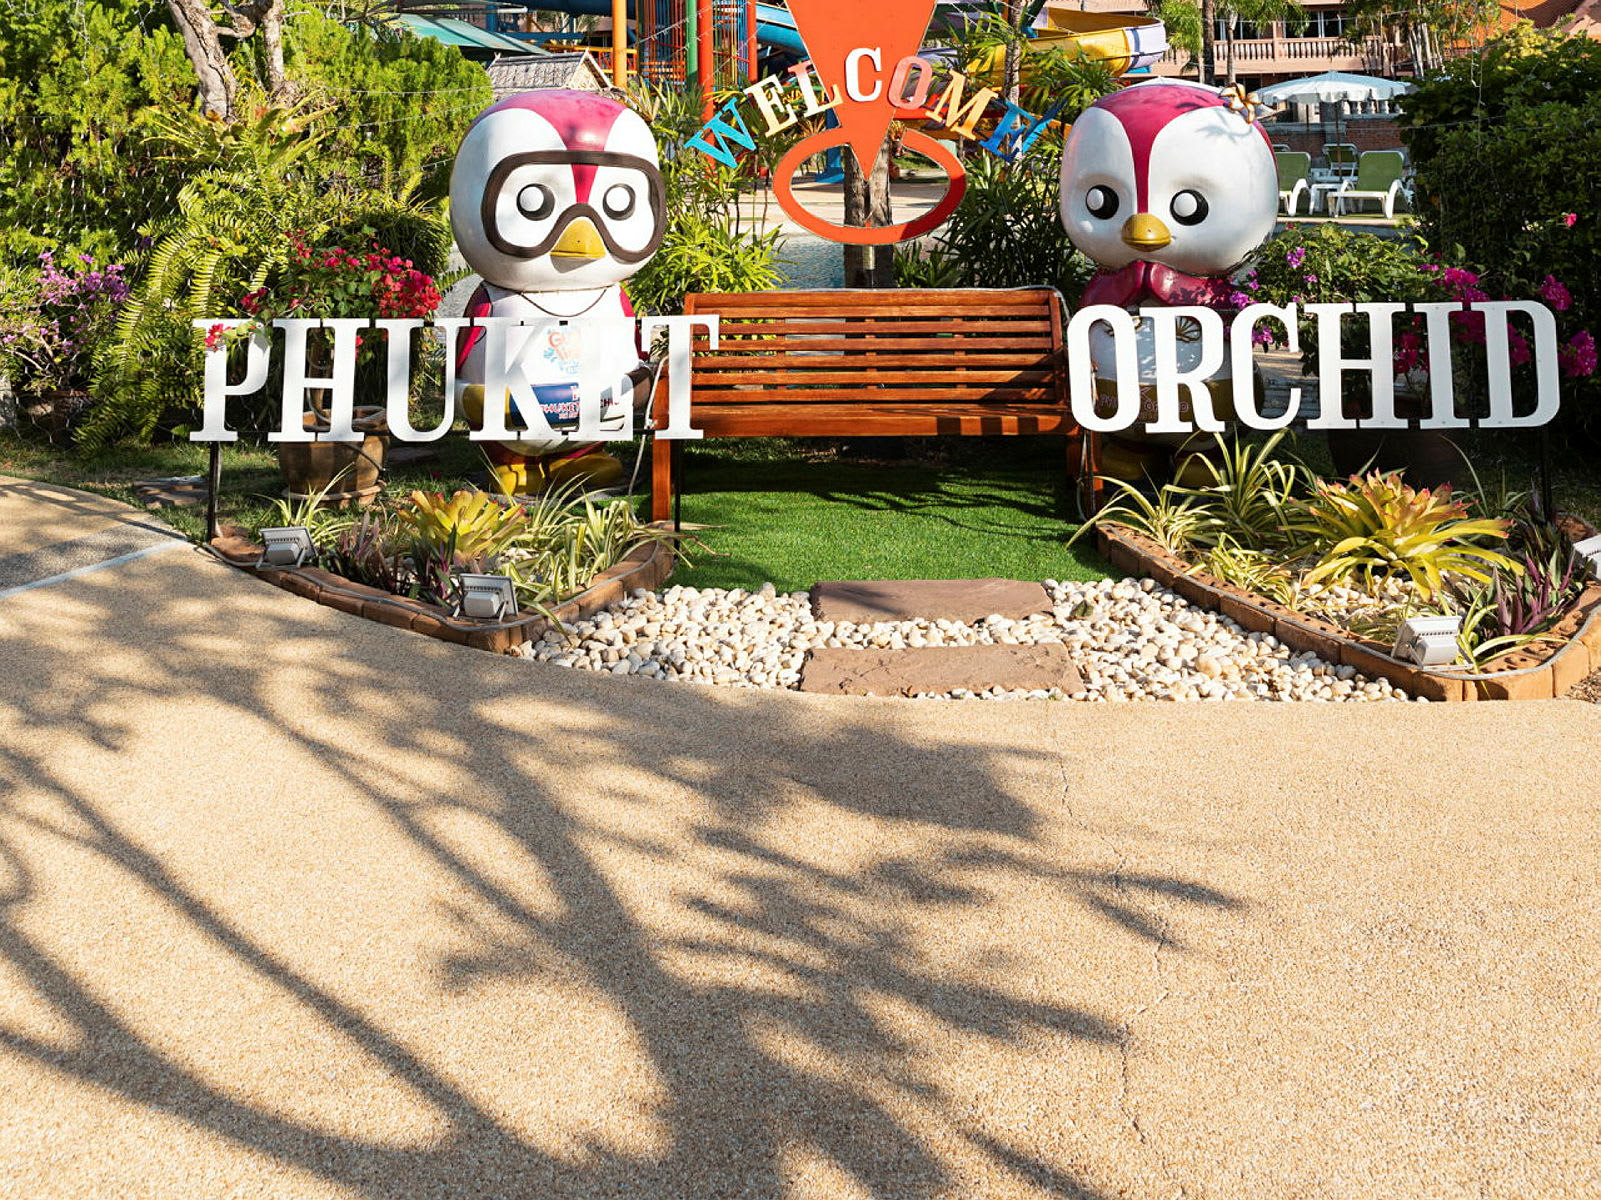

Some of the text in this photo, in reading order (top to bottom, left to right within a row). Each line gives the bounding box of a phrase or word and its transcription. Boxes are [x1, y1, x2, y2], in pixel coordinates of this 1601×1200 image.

[683, 46, 1044, 169] WELCOME
[190, 300, 1561, 443] PHUKET ORCHID
